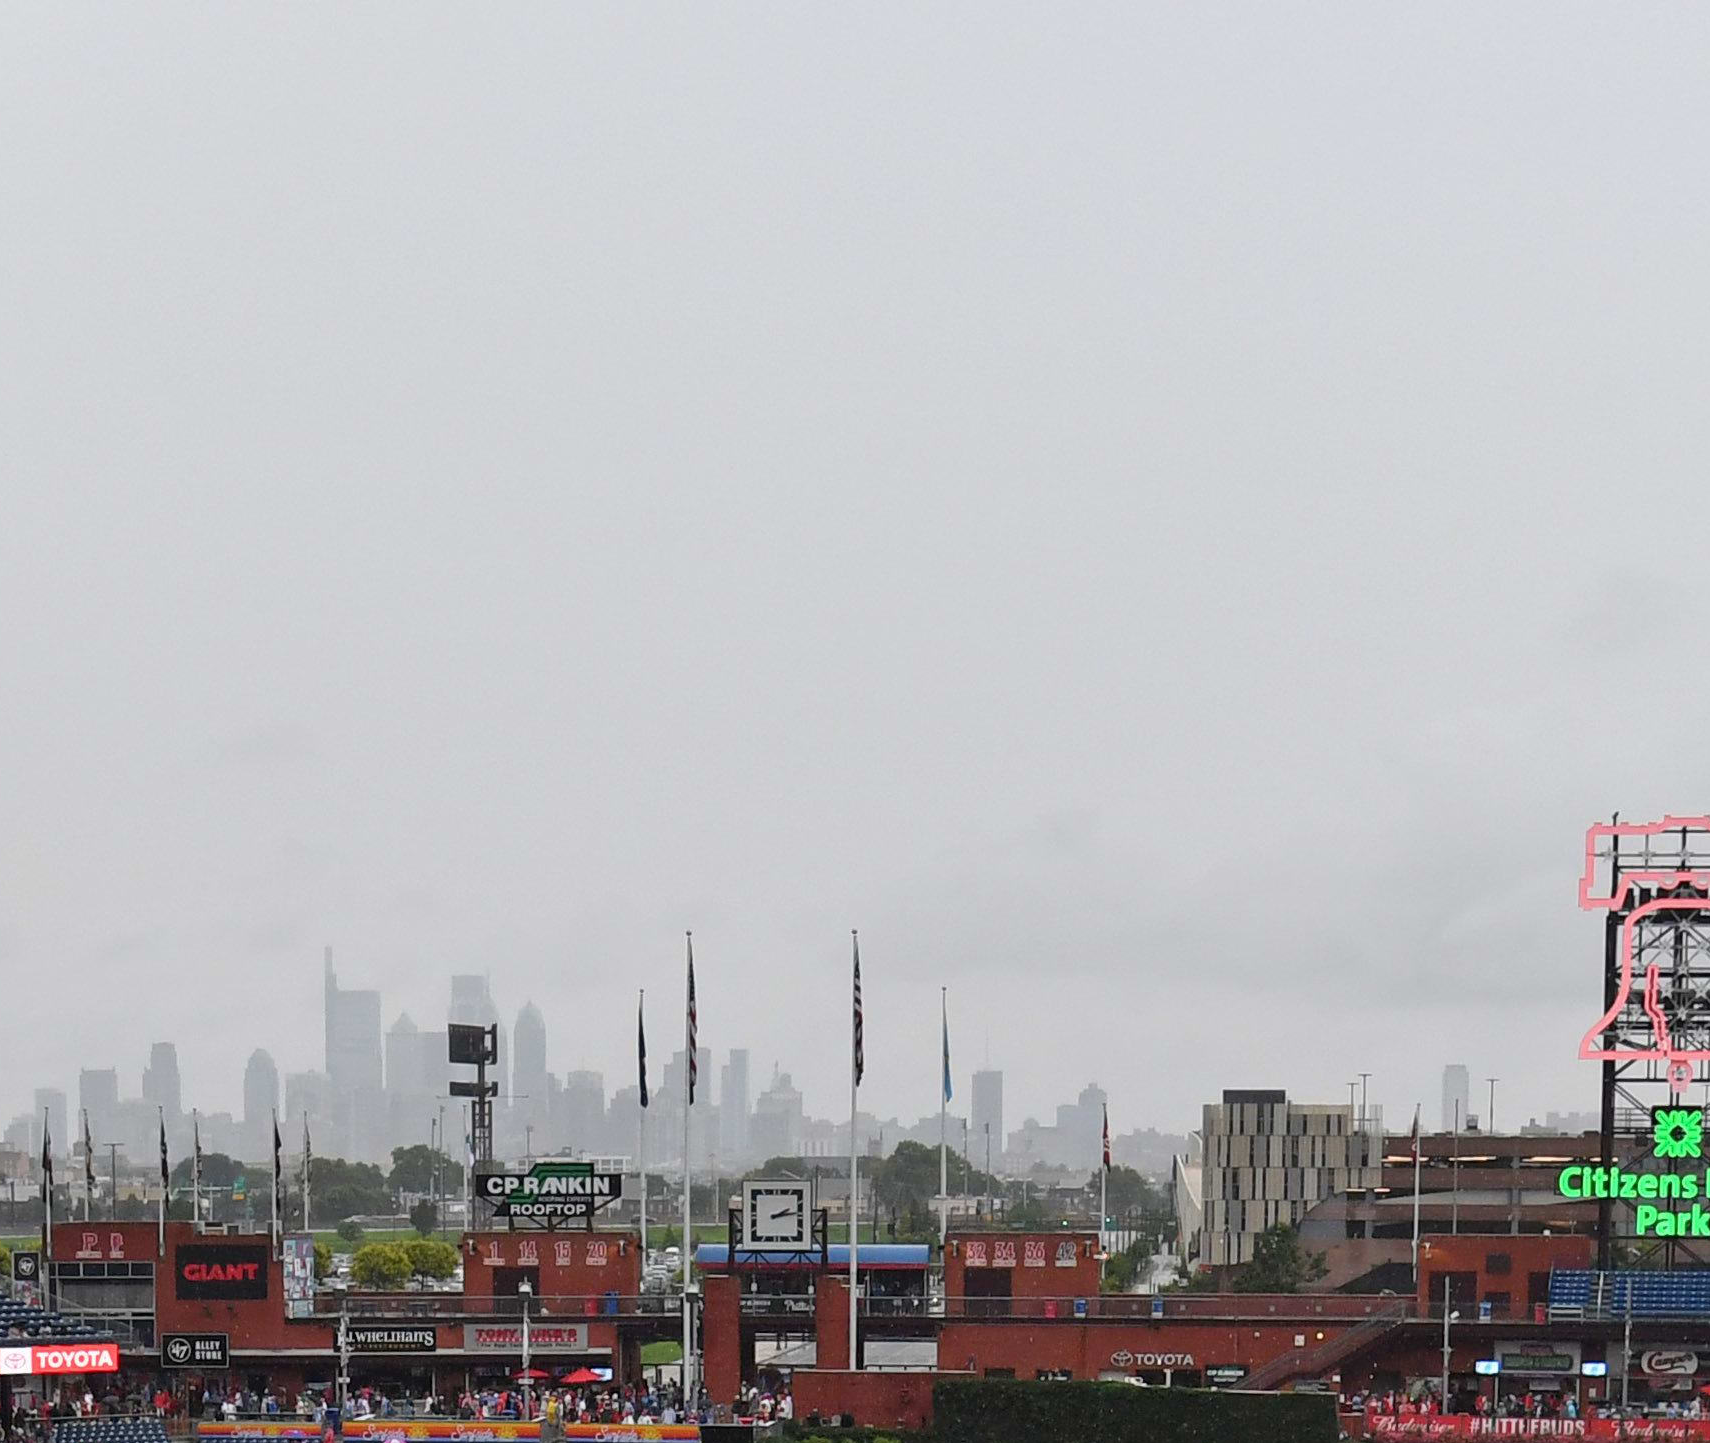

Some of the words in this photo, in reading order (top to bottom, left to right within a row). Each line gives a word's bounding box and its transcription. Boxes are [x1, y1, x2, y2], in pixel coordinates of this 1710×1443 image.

[487, 1177, 519, 1194] CP
[524, 1177, 610, 1194] RANKIN
[1559, 1166, 1700, 1200] Citizens
[510, 1203, 587, 1215] ROOFTOP
[489, 1240, 500, 1259] 1
[519, 1241, 537, 1259] 14
[554, 1241, 571, 1259] 15
[587, 1241, 607, 1259] 20
[966, 1241, 987, 1260] 32
[994, 1241, 1016, 1260] 34
[1024, 1241, 1045, 1260] 36
[1056, 1241, 1077, 1260] 42
[183, 1263, 260, 1282] GIANT
[195, 1340, 221, 1350] ALLEY
[37, 1350, 113, 1368] TOYOTA
[195, 1350, 222, 1361] STORE
[1134, 1354, 1194, 1366] TOYOTA
